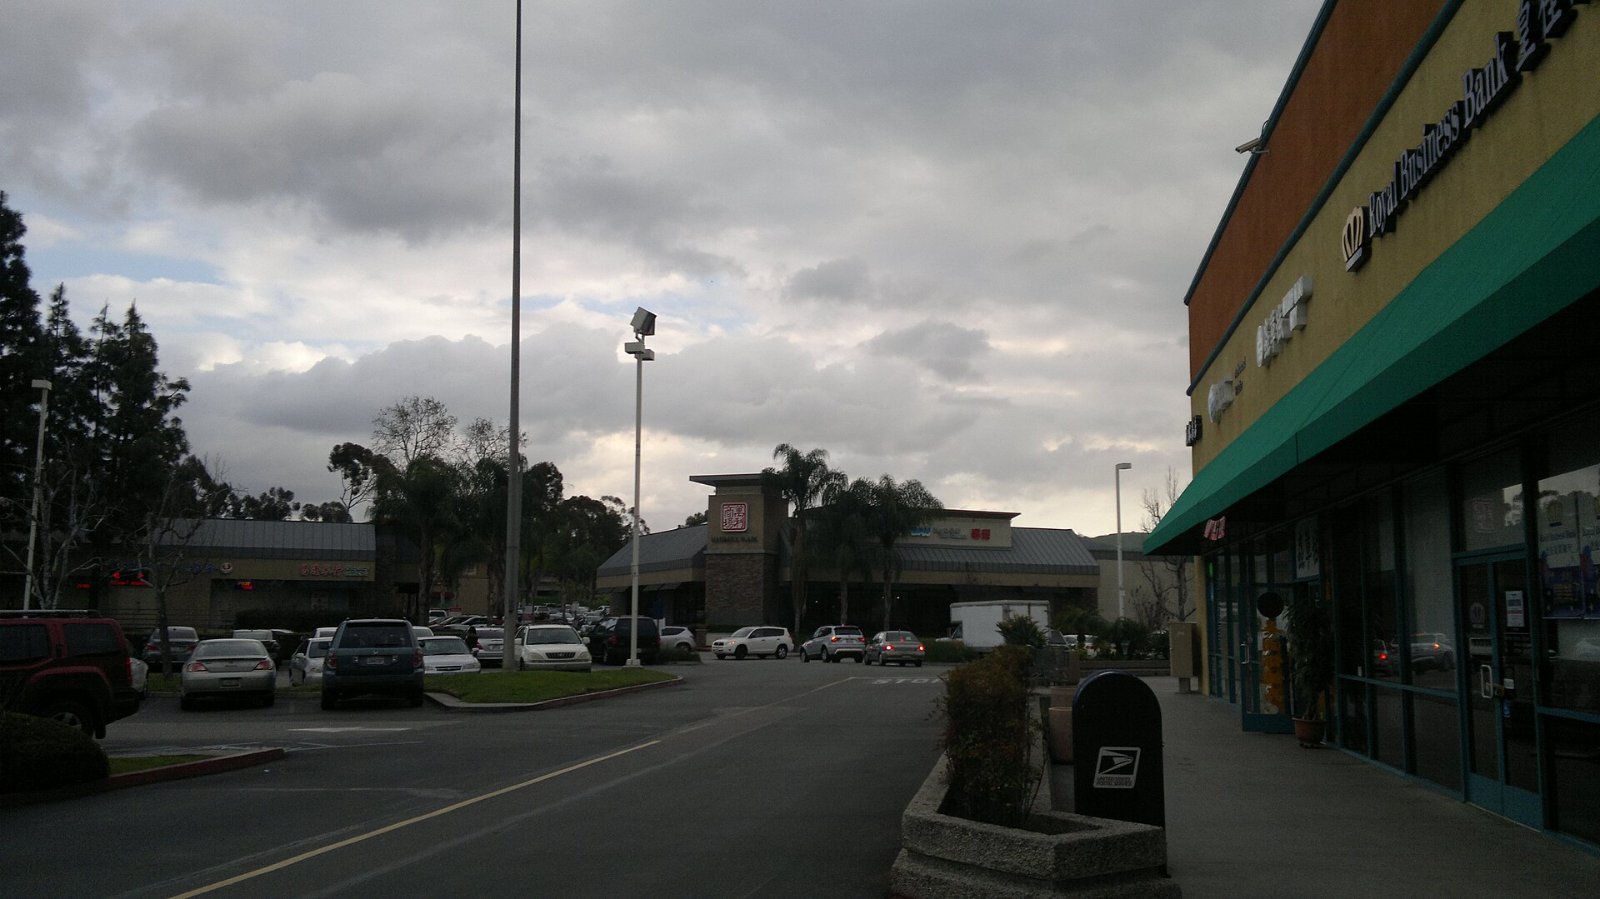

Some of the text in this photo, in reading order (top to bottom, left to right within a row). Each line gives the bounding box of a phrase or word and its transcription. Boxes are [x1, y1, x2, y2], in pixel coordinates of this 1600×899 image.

[1368, 161, 1400, 238] Royal
[1400, 101, 1461, 200] Business
[1462, 33, 1510, 129] Bank
